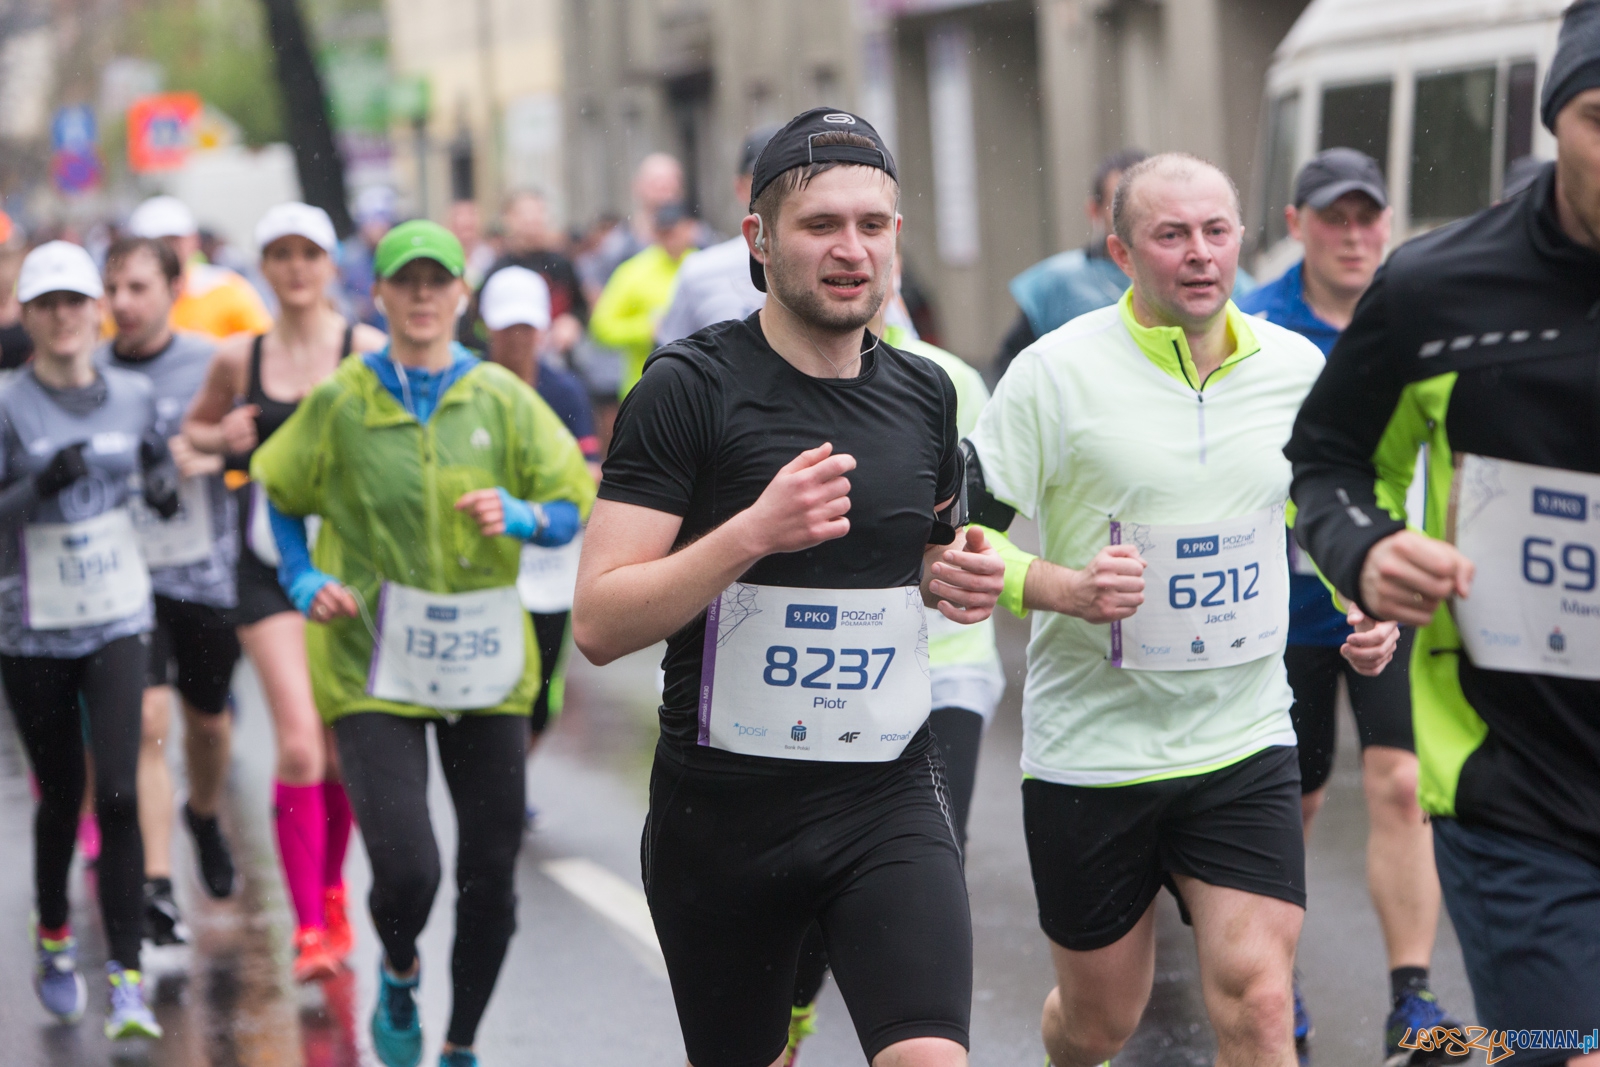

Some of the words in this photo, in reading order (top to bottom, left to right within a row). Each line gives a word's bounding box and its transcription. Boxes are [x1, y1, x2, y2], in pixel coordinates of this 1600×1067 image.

[1192, 540, 1214, 553] PKO
[1522, 535, 1596, 593] 69
[1168, 561, 1260, 610] 6212
[793, 611, 803, 623] 9.
[804, 611, 830, 623] PKO
[1204, 610, 1237, 625] Jacek
[405, 625, 501, 661] 13236
[763, 645, 896, 691] 8237
[813, 696, 848, 710] Piotr
[738, 725, 769, 737] posir
[838, 731, 861, 744] 4F
